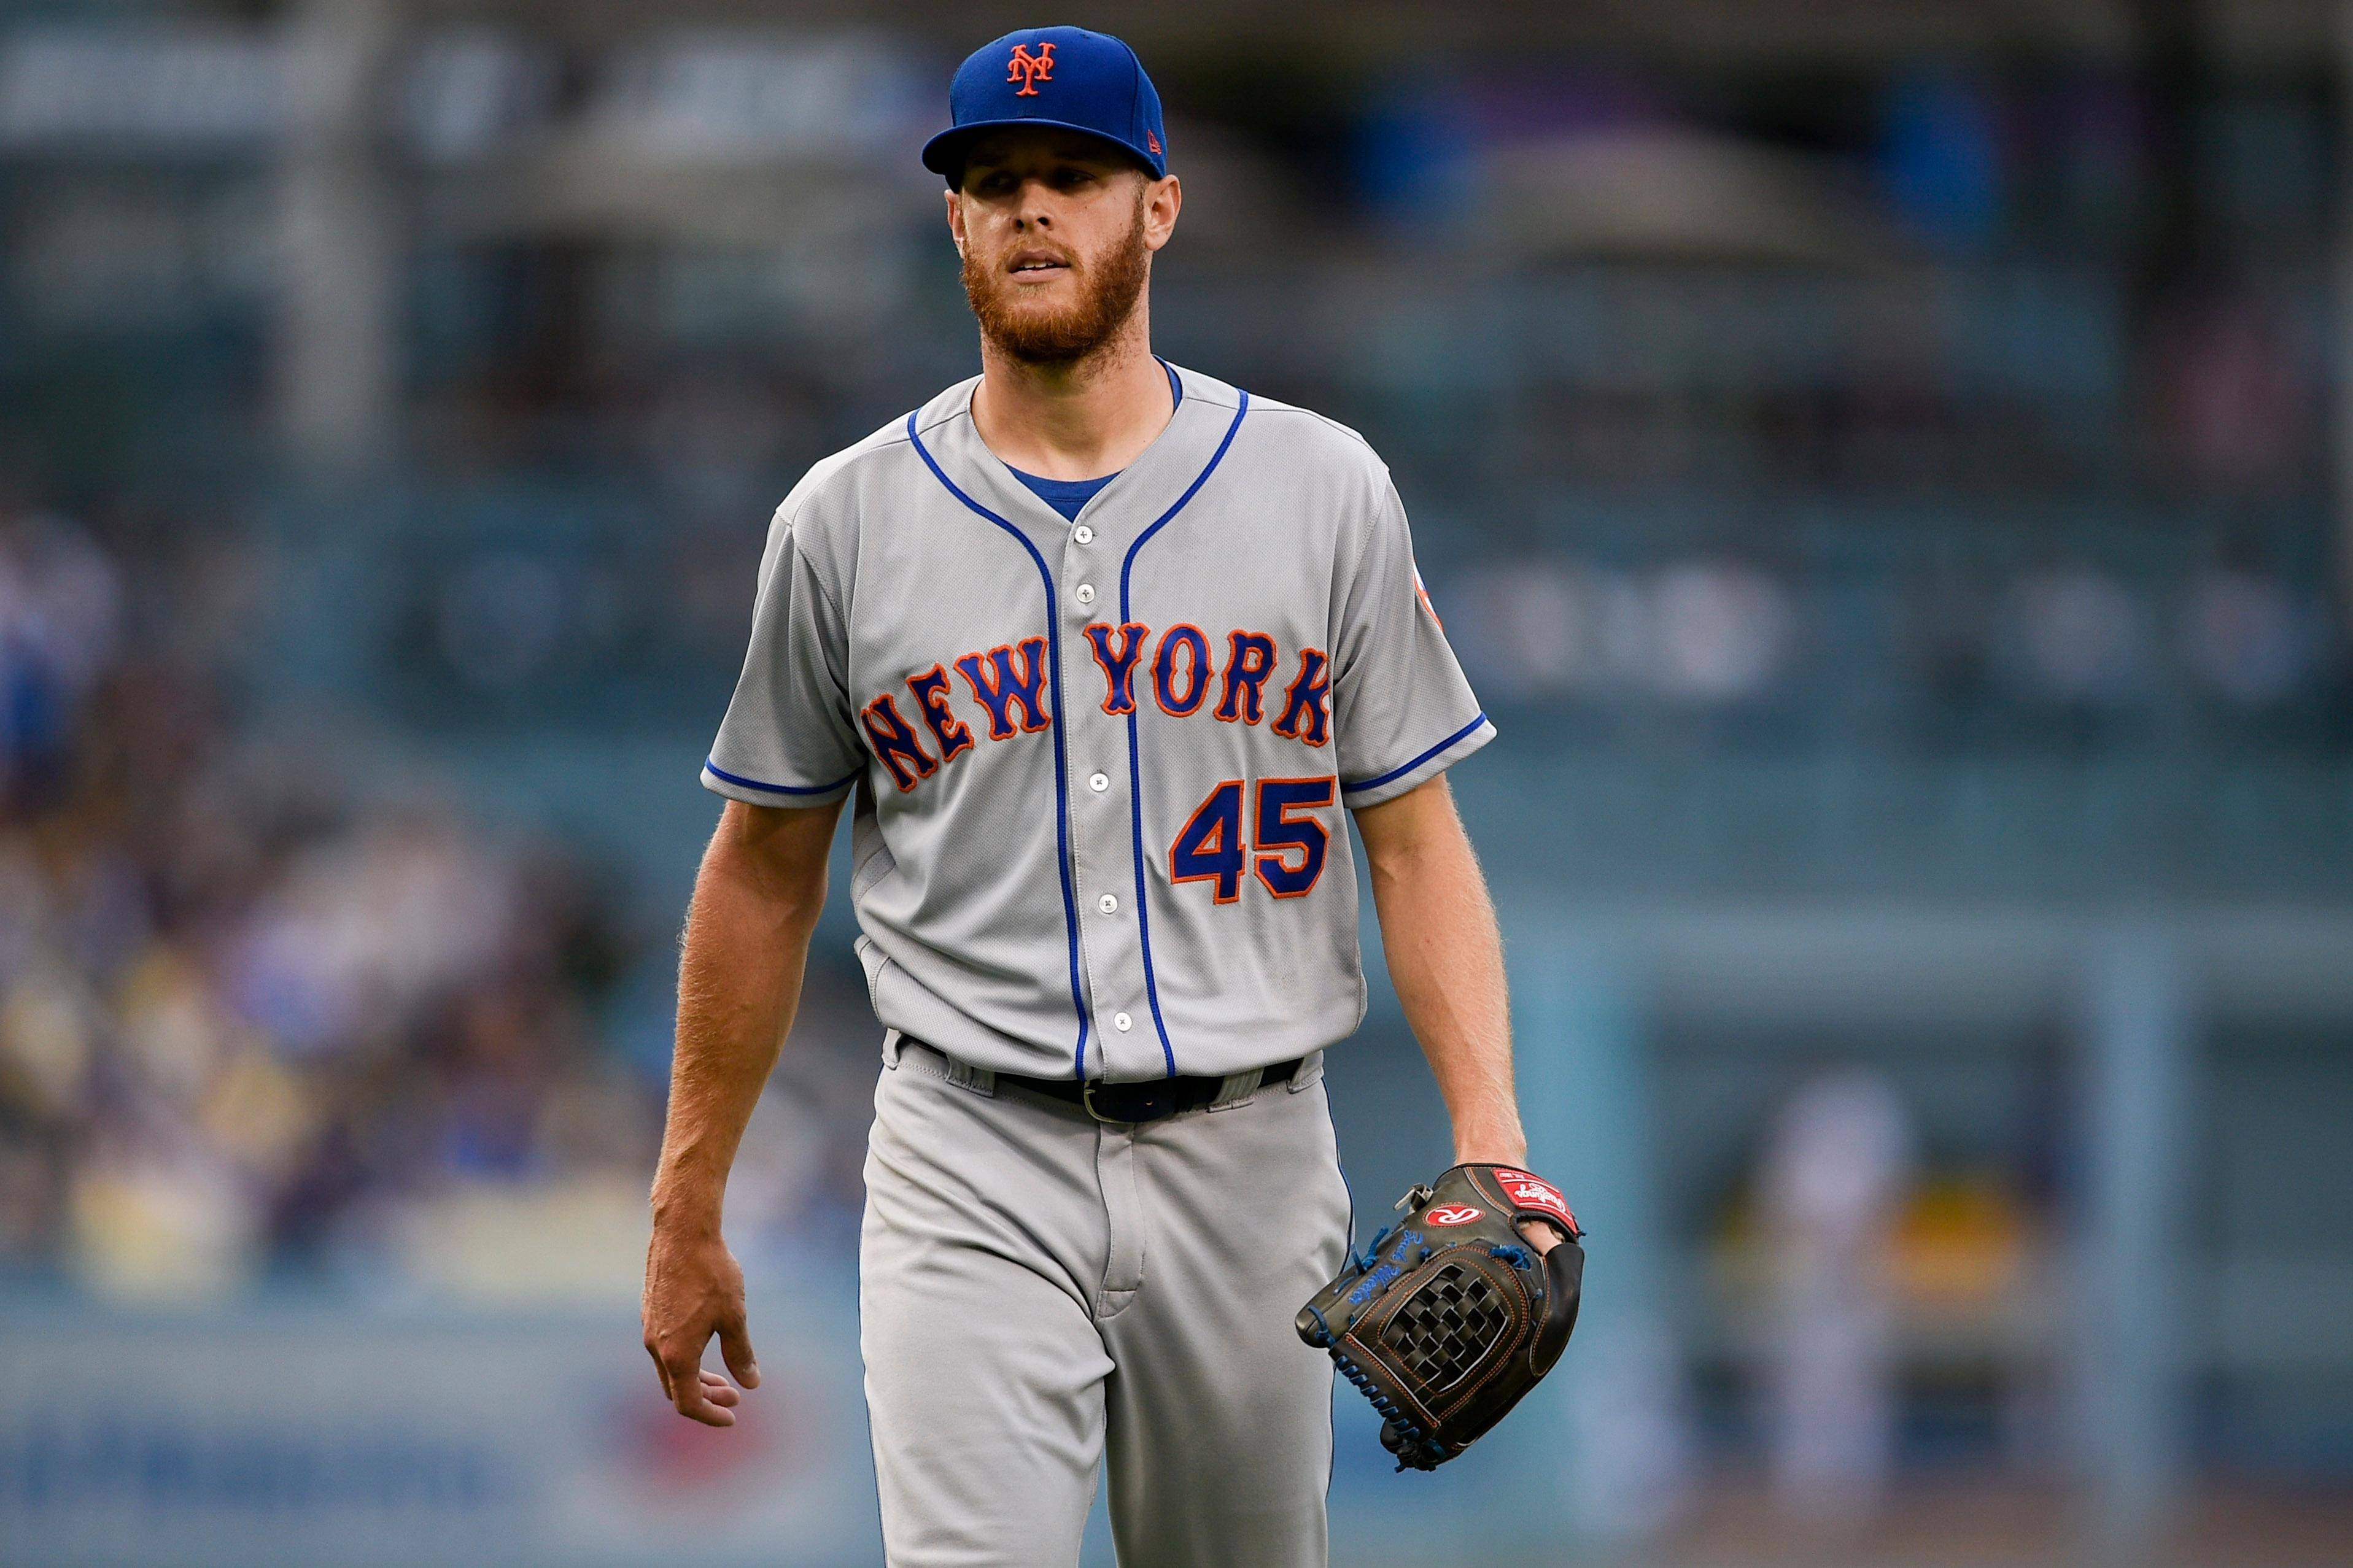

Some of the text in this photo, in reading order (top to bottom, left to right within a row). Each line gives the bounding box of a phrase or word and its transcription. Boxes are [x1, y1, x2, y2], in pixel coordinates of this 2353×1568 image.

[1007, 42, 1056, 96] NY
[861, 622, 1330, 793] NEW YORK
[1169, 775, 1336, 905] 45
[1514, 1183, 1566, 1213] Rawlings
